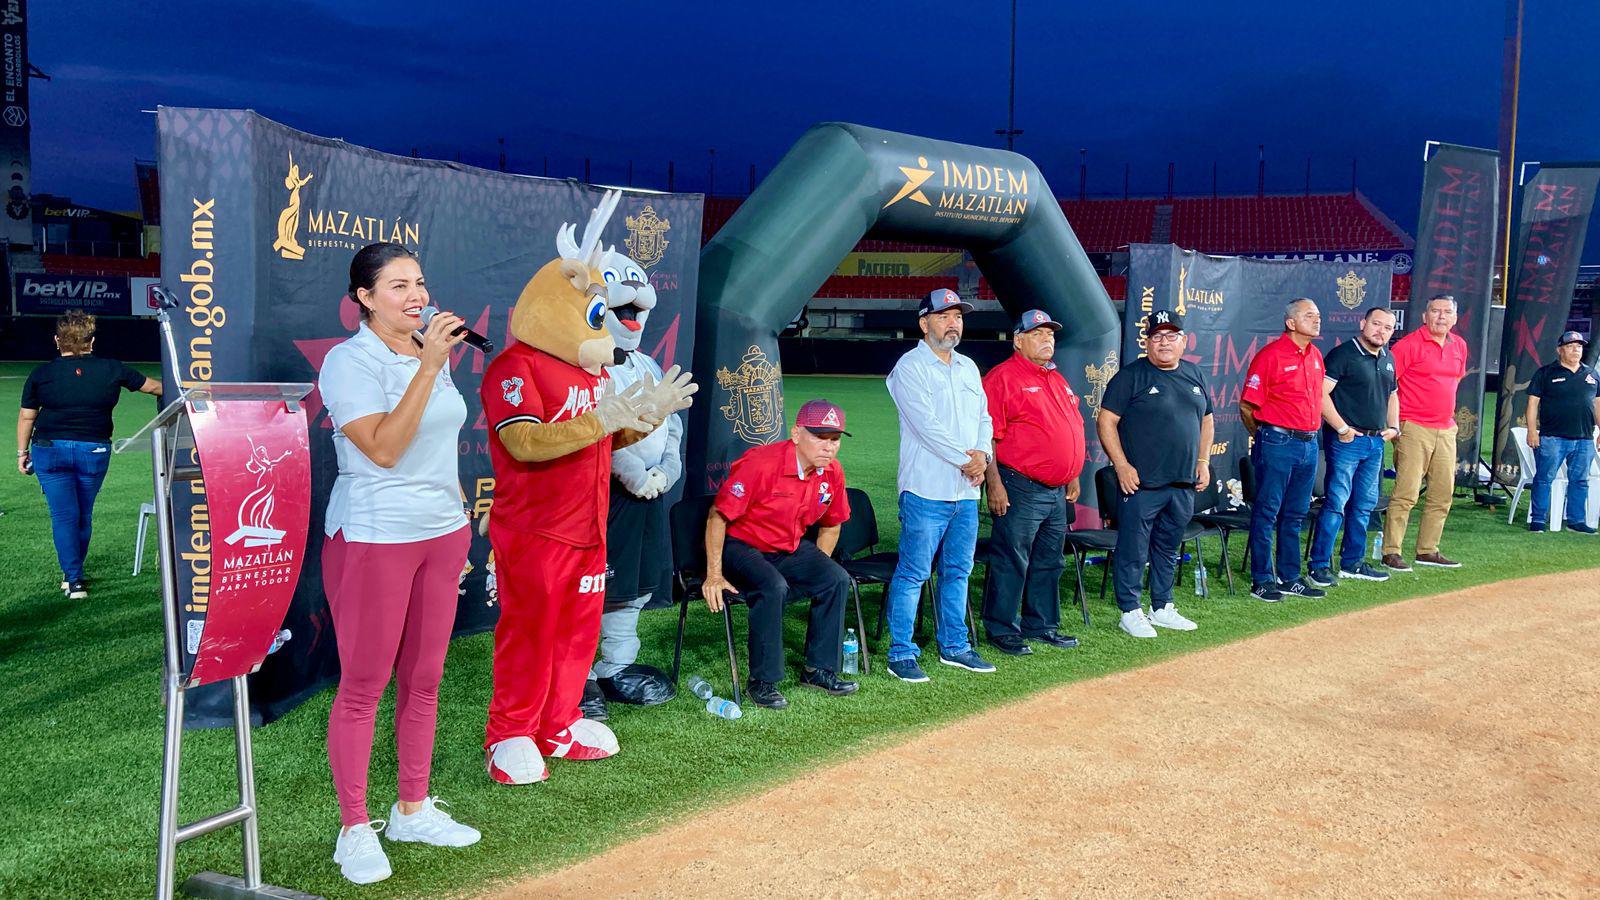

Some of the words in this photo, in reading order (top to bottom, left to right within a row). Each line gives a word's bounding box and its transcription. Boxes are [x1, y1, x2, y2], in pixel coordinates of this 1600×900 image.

[4, 33, 14, 87] ENCANTO
[14, 35, 22, 88] DESARROLLOS
[6, 89, 15, 102] EL
[942, 160, 1028, 195] IMDEM
[939, 191, 1028, 215] MAZATLÁN
[934, 211, 962, 219] INSTITUTO
[308, 208, 419, 245] MAZATLÁN
[1427, 165, 1465, 291] IMDEM
[308, 240, 355, 250] BIENESTAR
[22, 279, 122, 299] betVIP.mx
[224, 549, 293, 569] MAZATLÁN
[220, 583, 248, 592] PARA
[255, 576, 289, 587] TODOS
[222, 567, 291, 583] BIENESTAR
[578, 572, 606, 594] 911
